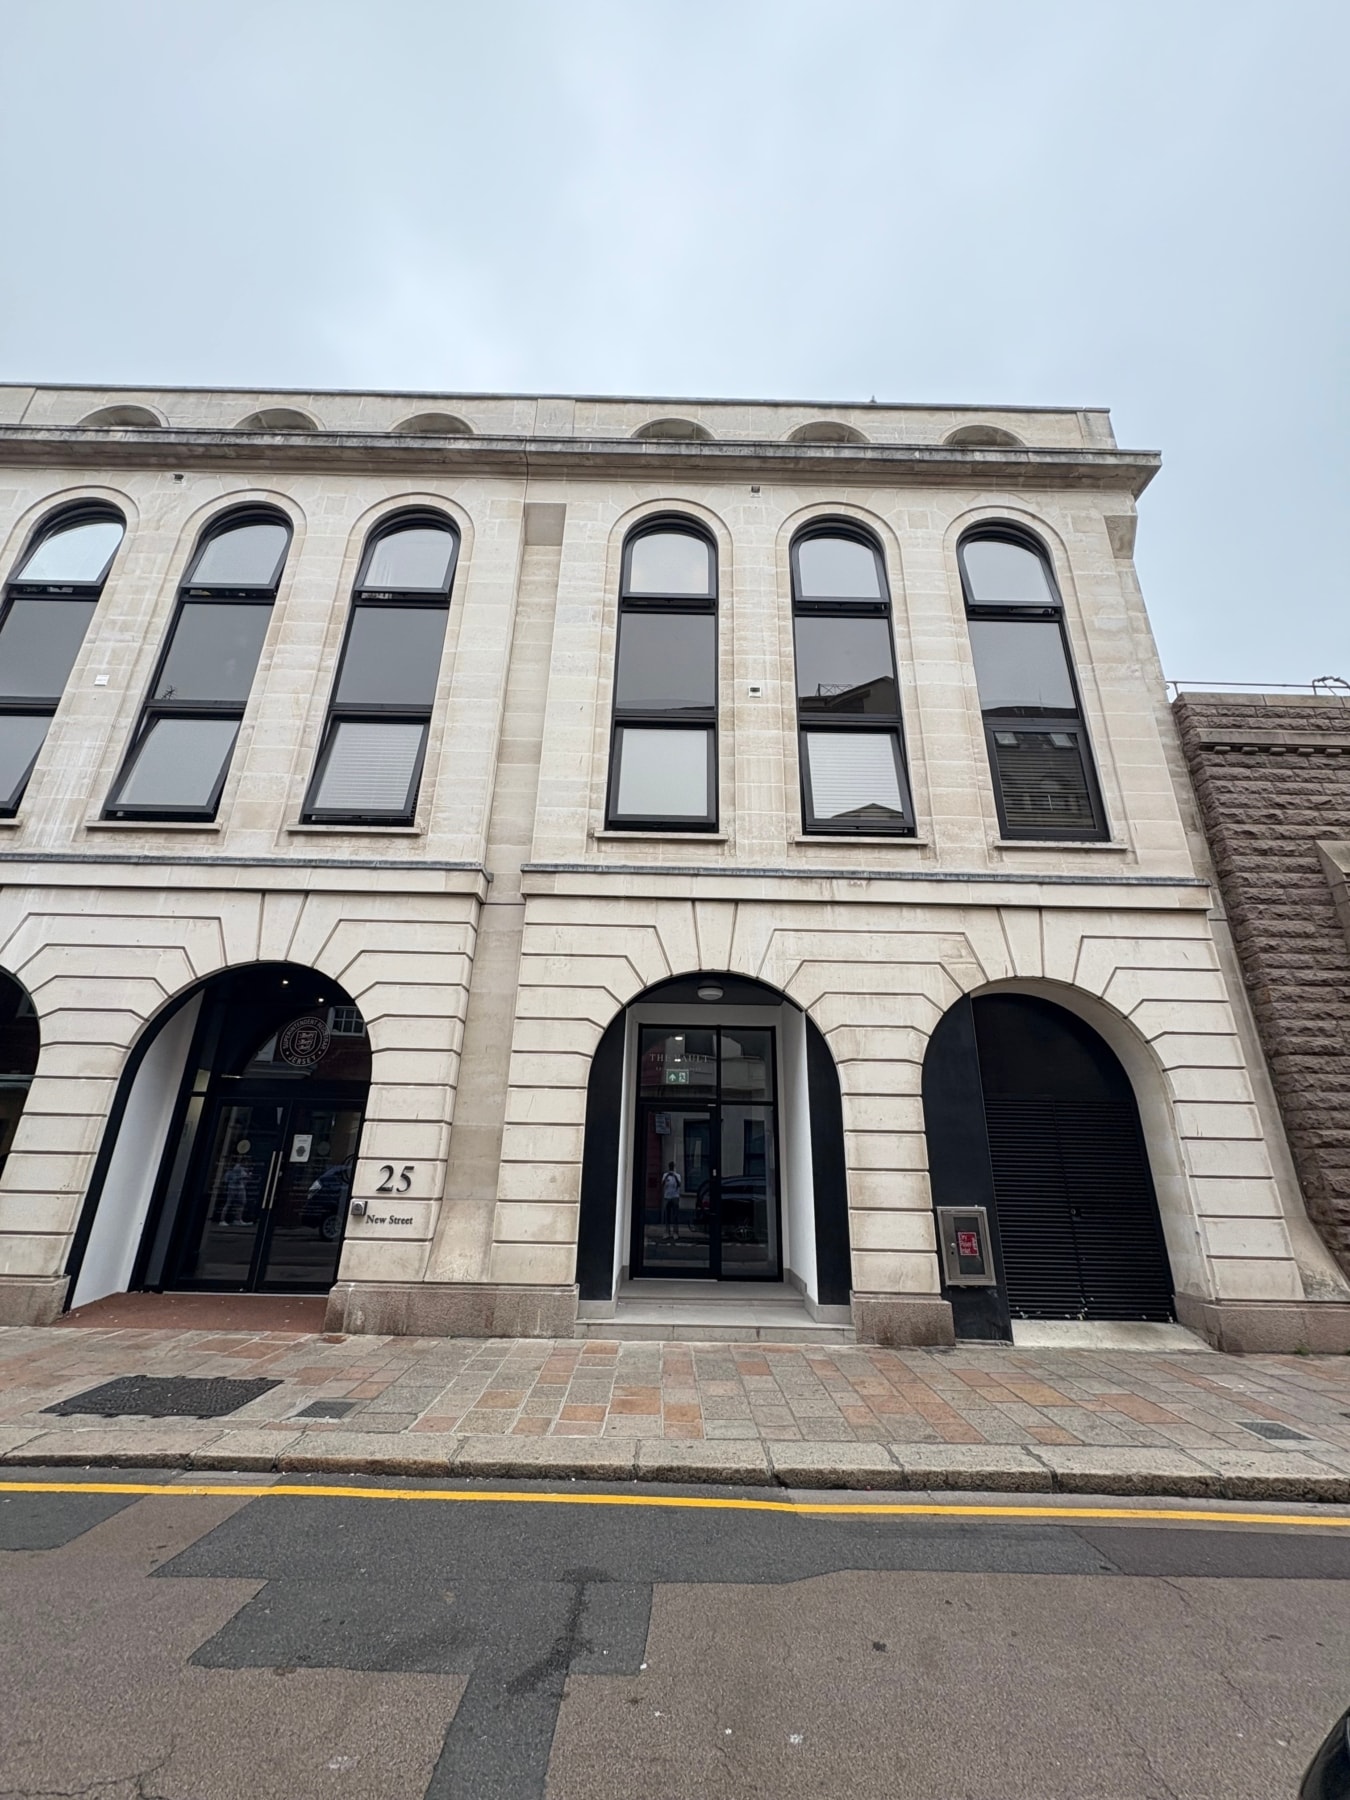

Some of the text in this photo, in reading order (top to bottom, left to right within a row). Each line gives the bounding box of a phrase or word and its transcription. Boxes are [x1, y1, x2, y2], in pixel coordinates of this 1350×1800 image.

[282, 1018, 317, 1050] SUPERINTENDENT
[288, 1055, 316, 1064] JERSEY
[650, 1053, 672, 1062] THE
[375, 1164, 415, 1193] 25
[365, 1214, 414, 1225] New Street
